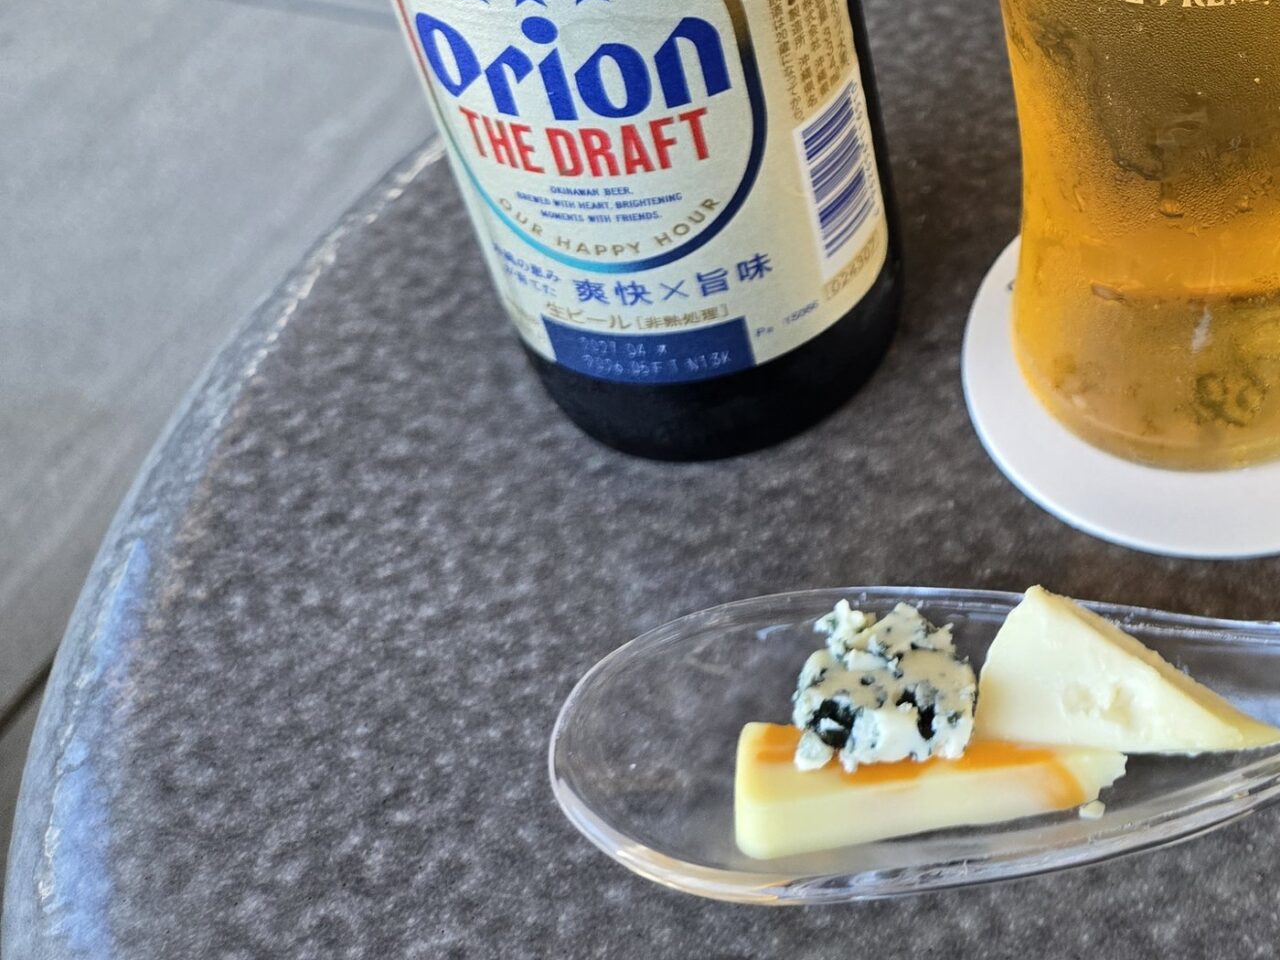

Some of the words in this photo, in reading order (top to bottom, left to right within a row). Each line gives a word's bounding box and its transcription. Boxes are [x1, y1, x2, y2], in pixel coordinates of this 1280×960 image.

[415, 12, 732, 121] Orion
[458, 106, 546, 174] THE
[545, 107, 709, 178] DRAFT
[499, 198, 543, 237] OUR
[557, 236, 641, 256] HAPPY
[654, 197, 722, 246] HOUR
[615, 192, 683, 209] BRIGHTENING
